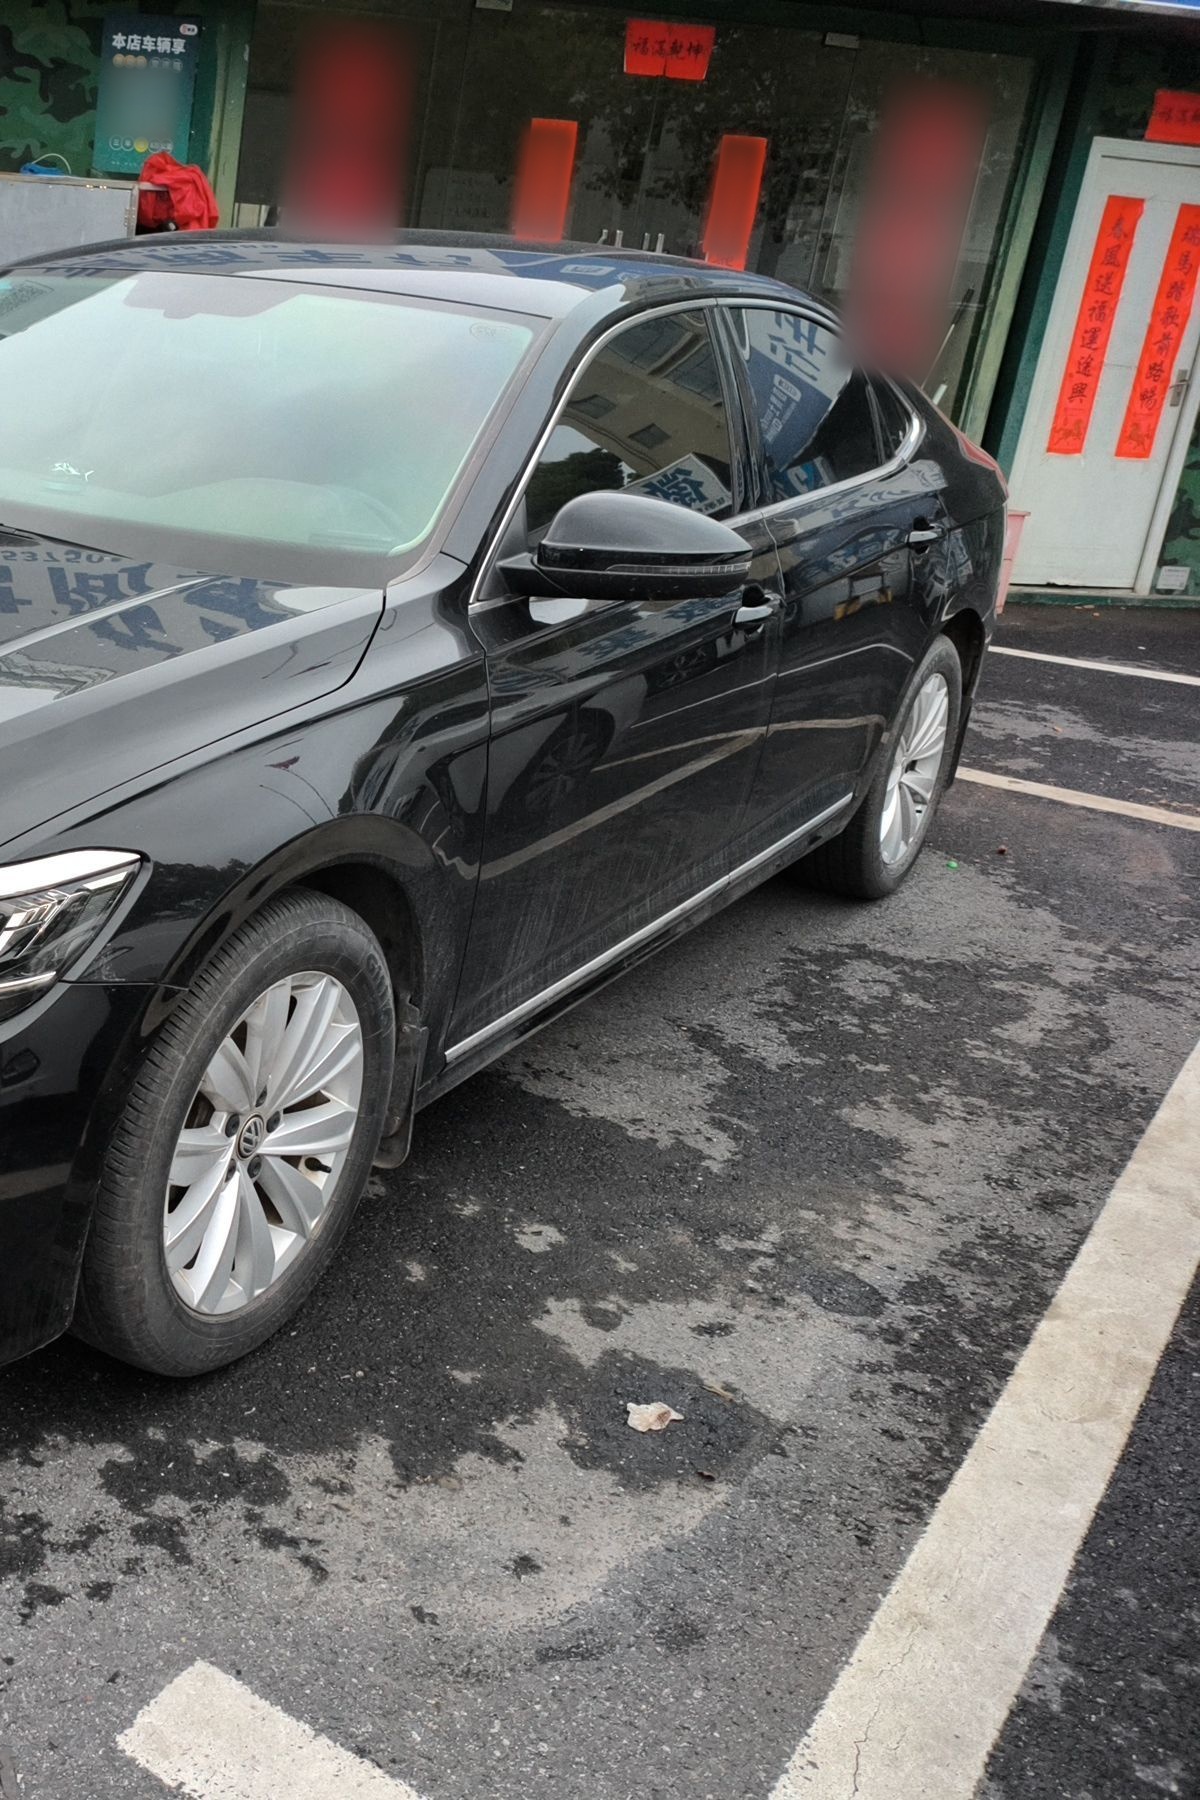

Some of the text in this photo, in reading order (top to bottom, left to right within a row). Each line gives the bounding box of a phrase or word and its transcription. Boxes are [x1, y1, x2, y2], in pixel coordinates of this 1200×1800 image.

[111, 31, 187, 55] 本店车辆享
